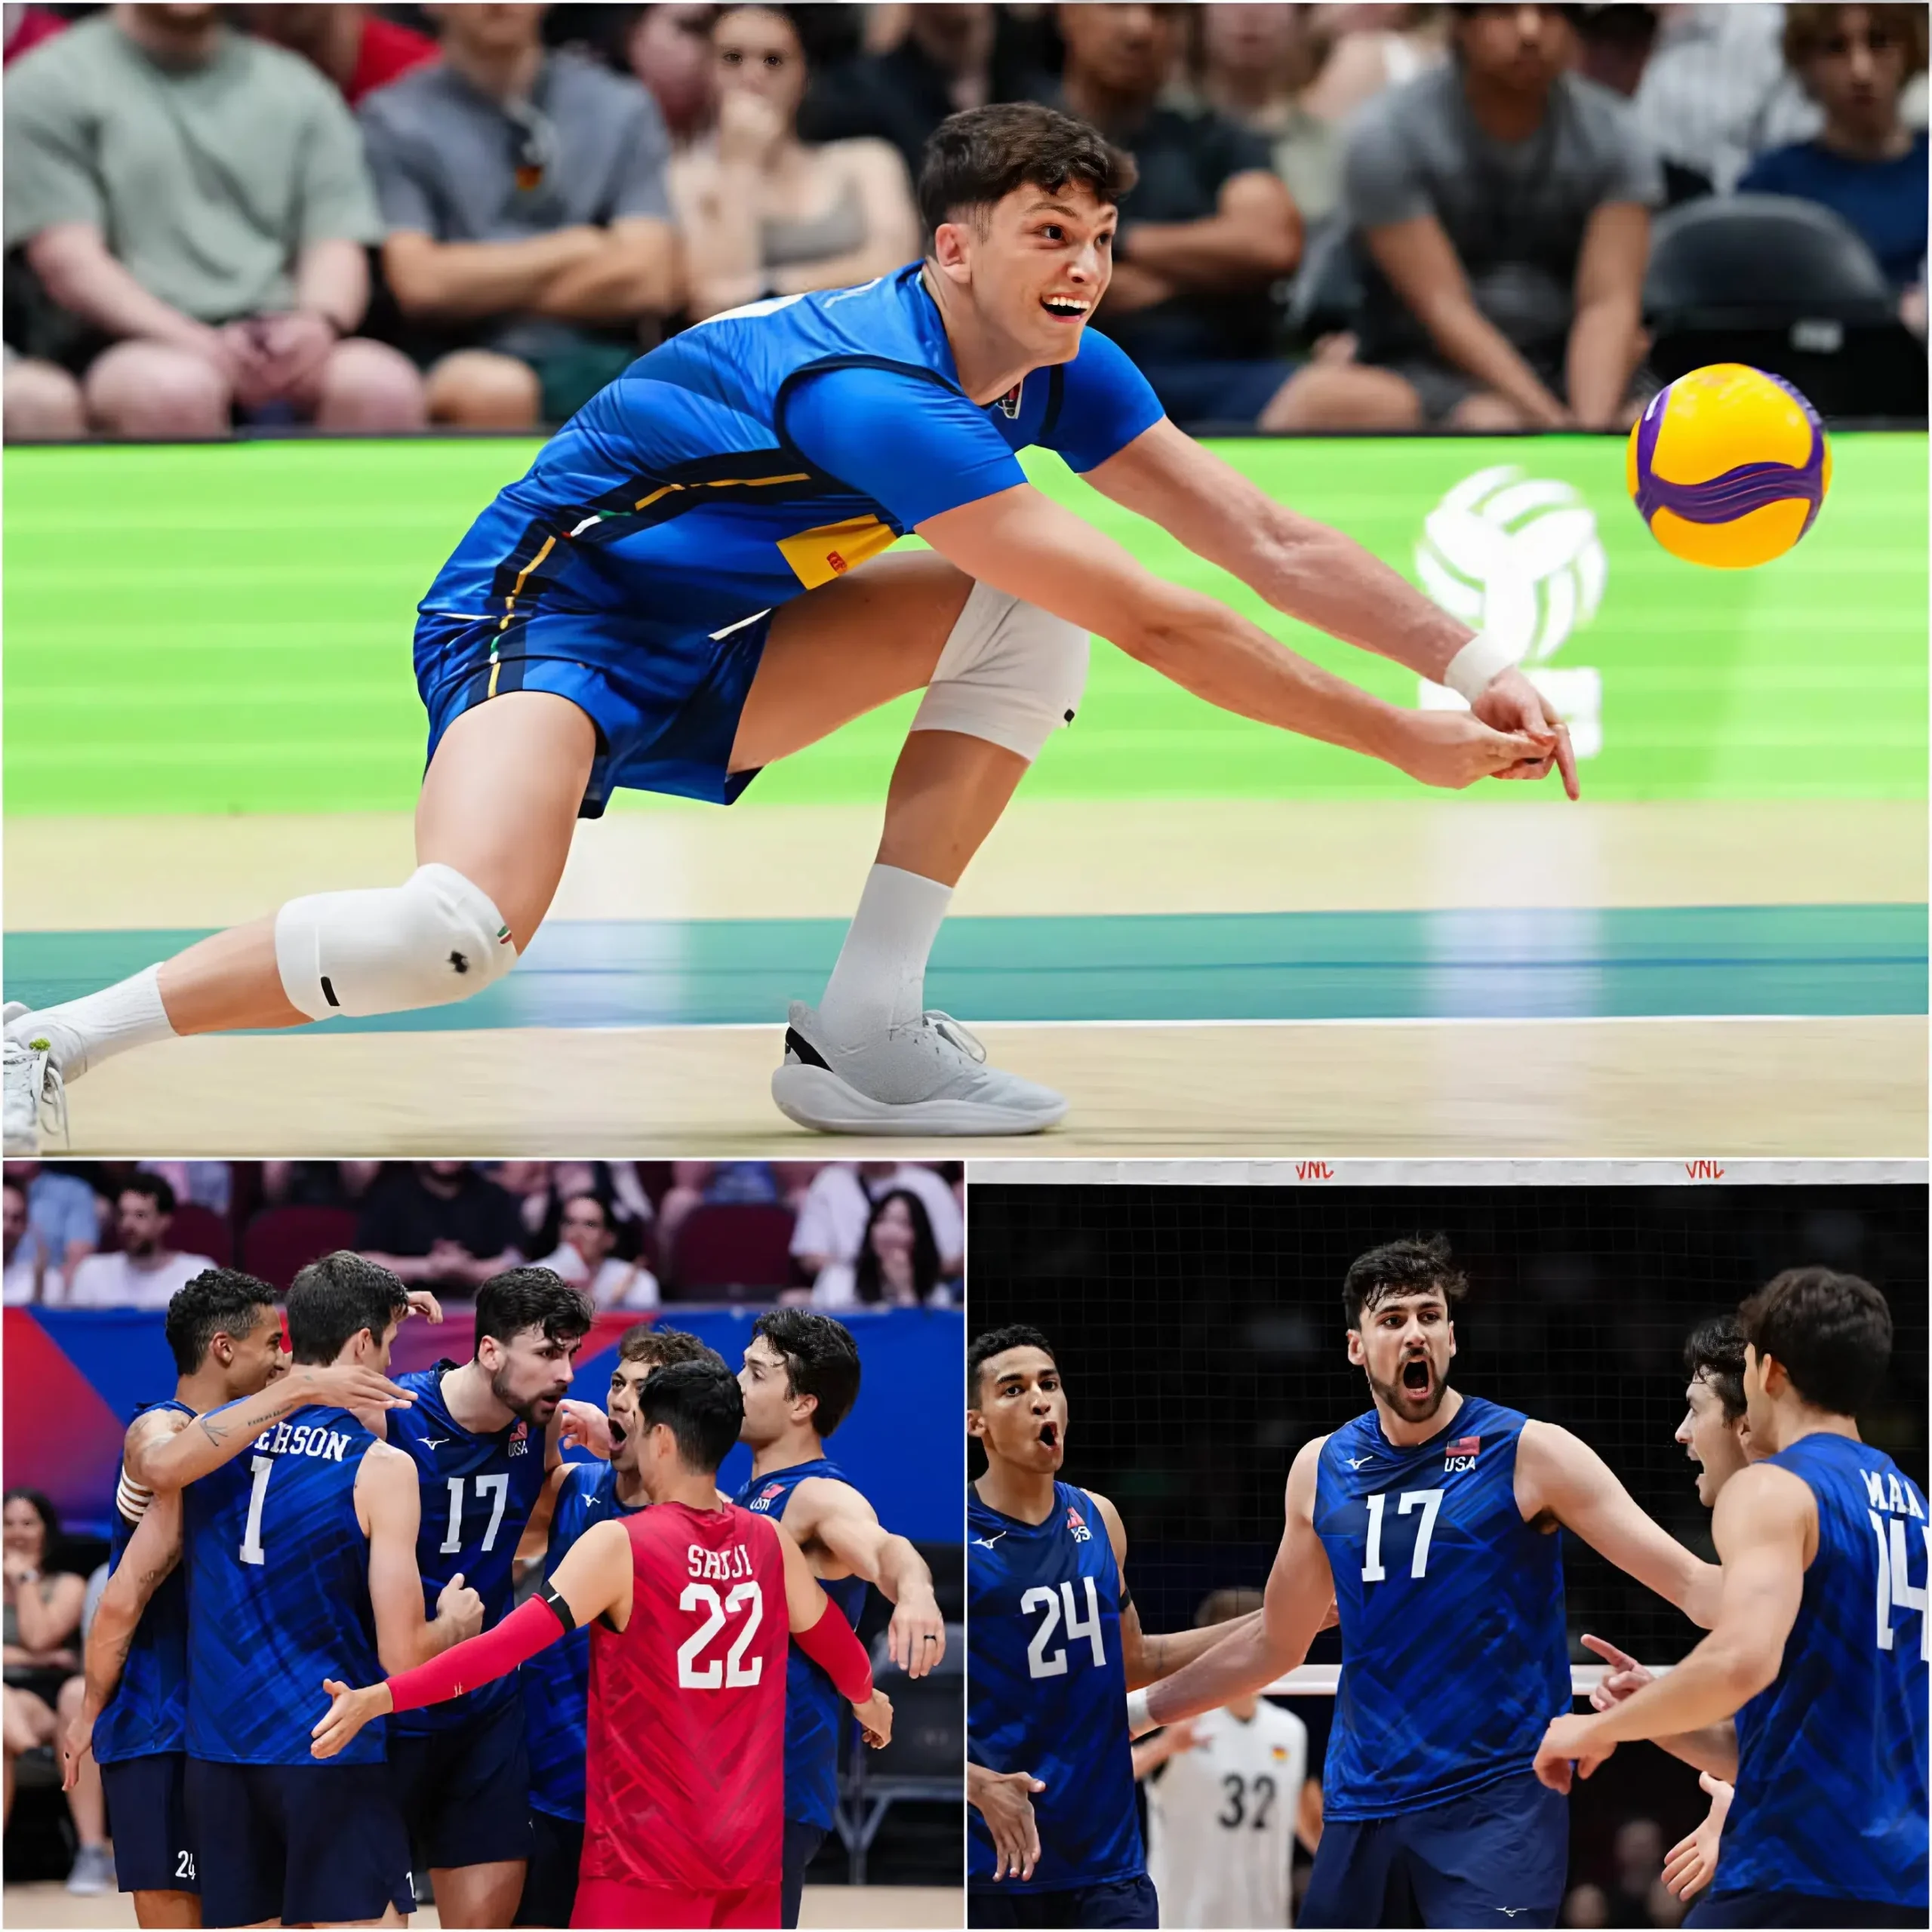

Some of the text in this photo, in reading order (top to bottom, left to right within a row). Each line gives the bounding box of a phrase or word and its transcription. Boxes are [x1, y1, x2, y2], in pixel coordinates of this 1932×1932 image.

[254, 1421, 352, 1462] ERSON
[1444, 1456, 1476, 1472] USA
[239, 1455, 274, 1565] 1
[439, 1472, 509, 1554] 17
[1361, 1488, 1445, 1582] 17
[1020, 1576, 1107, 1678] 24
[1868, 1509, 1930, 1663] 14
[677, 1580, 763, 1689] 22
[1219, 1774, 1275, 1829] 32
[174, 1850, 196, 1881] 24
